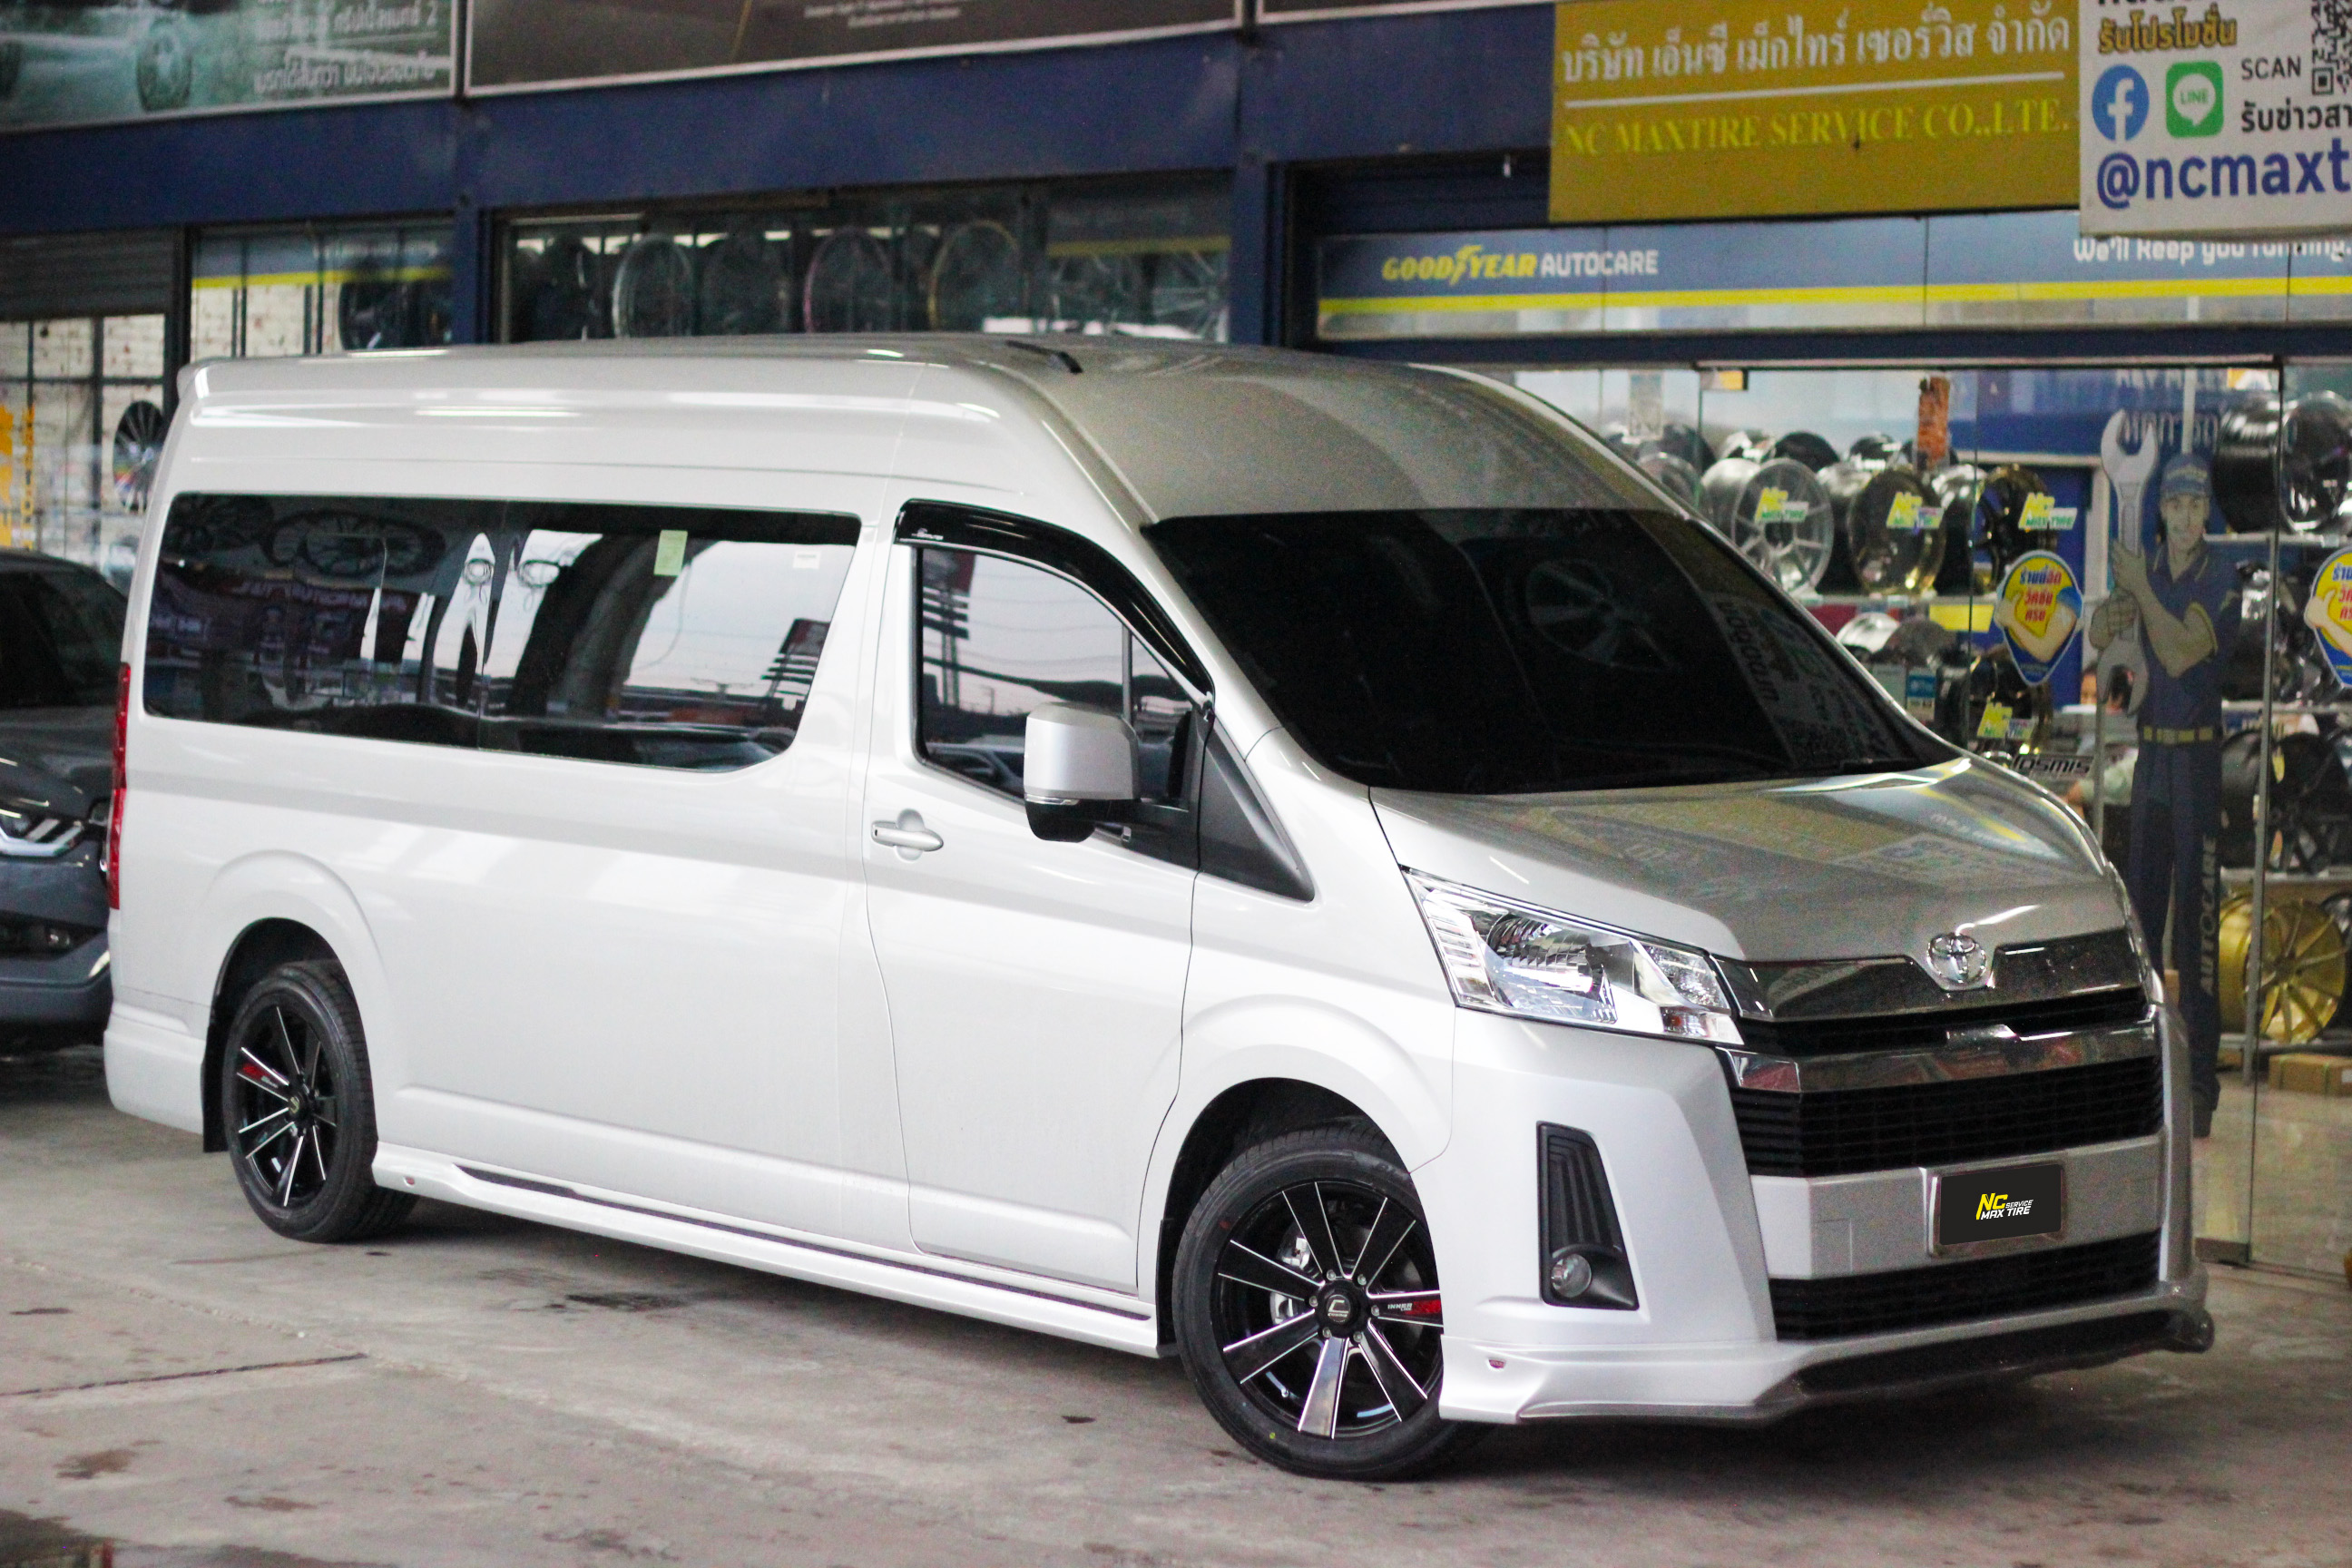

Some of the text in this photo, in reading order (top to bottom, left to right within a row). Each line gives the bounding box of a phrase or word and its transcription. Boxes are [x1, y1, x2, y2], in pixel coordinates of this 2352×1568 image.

[1562, 31, 1644, 83] บริษัท
[1651, 22, 1729, 77] เอ็นซี
[1856, 2, 1977, 64] เซอร์วิส
[1986, 0, 2070, 55] จำกัด
[2098, 2, 2238, 54] รับโปรโมชั่น
[2241, 56, 2302, 81] SCAN
[2180, 89, 2210, 105] LINE
[1565, 122, 1606, 155] NC
[1616, 116, 1759, 152] MAXTIRE
[1771, 106, 1915, 145] SERVICE
[2097, 137, 2352, 210] @ncmaxt
[1381, 244, 1660, 286] GOODYEAR AUTOCARE
